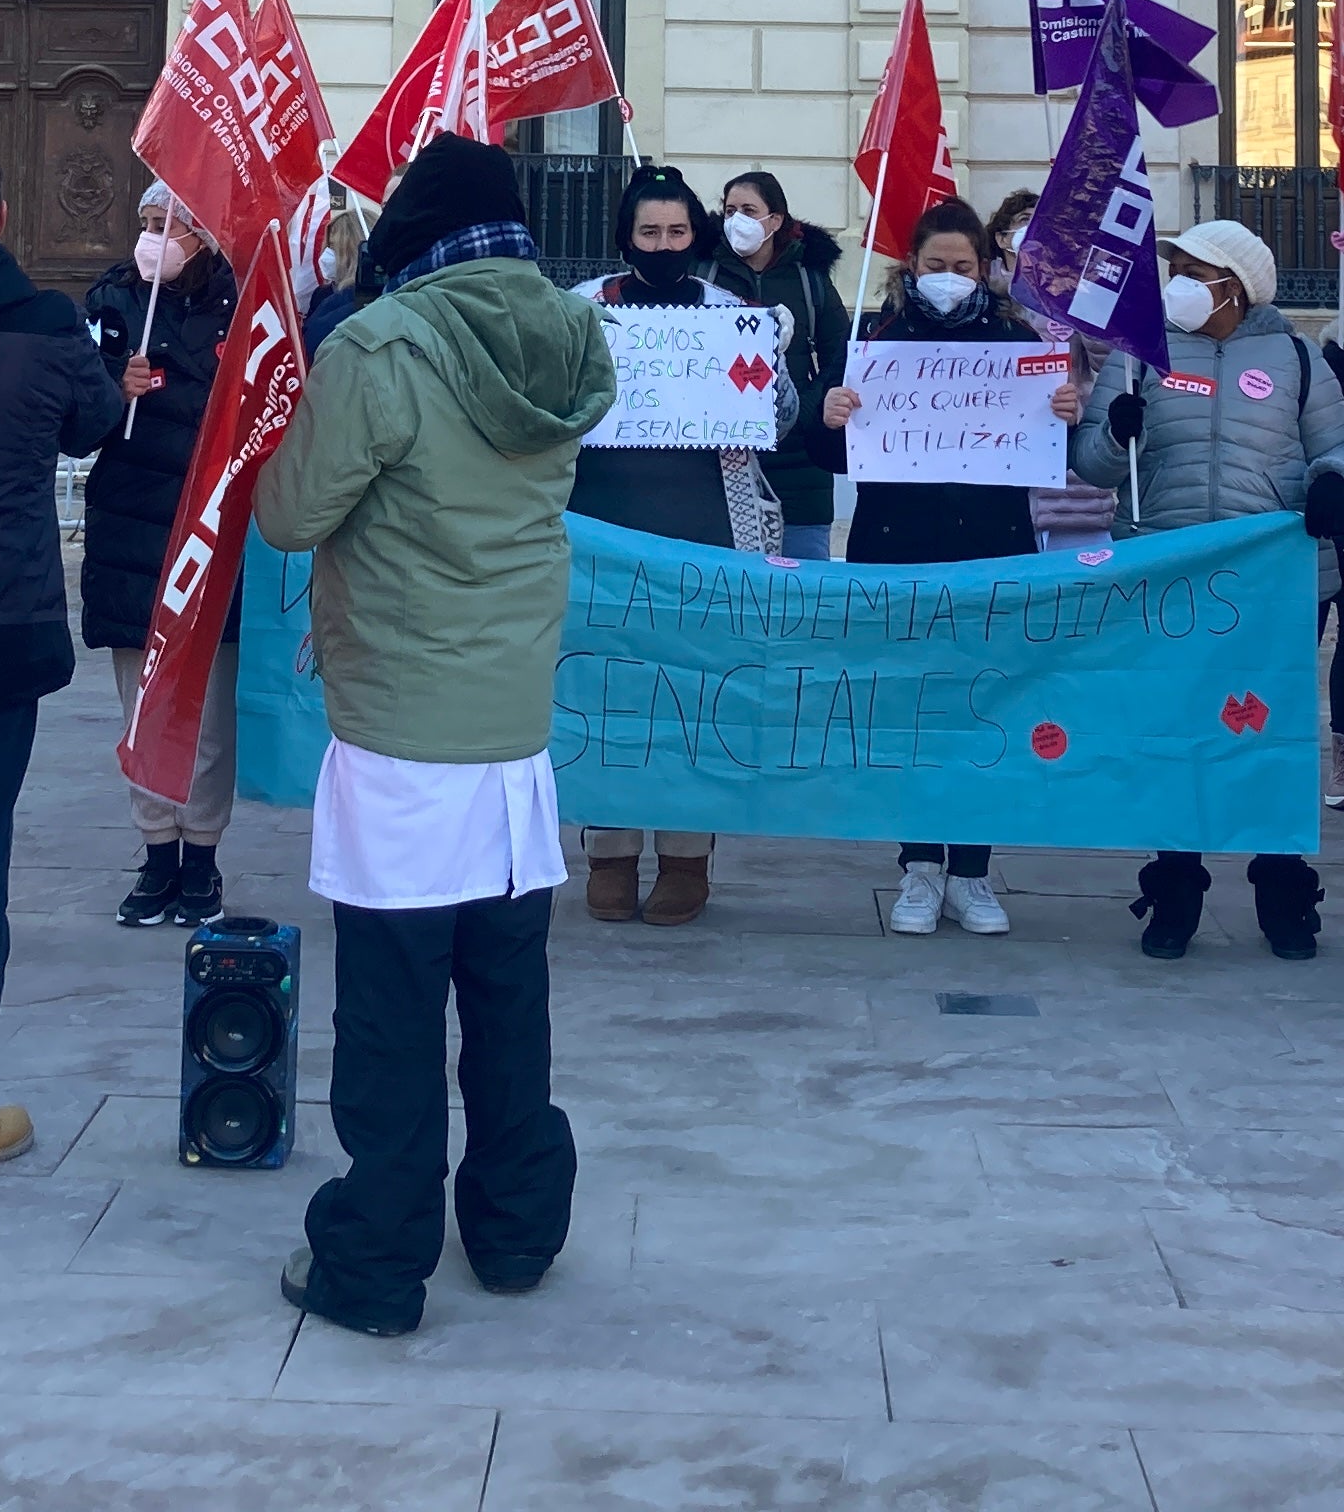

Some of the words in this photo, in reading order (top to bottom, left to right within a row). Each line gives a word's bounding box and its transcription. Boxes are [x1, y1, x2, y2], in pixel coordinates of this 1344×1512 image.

[213, 95, 252, 163] Obreras
[210, 118, 251, 188] Mancha
[626, 323, 706, 353] SOMOS
[614, 356, 726, 383] BASURA
[862, 359, 900, 384] LA
[916, 356, 1015, 381] PATRONA
[1020, 360, 1068, 375] CCOO
[1162, 376, 1212, 396] CCOO
[875, 390, 920, 412] NOS
[930, 390, 1013, 412] QUIERE
[614, 414, 770, 441] ESENCIALES
[882, 429, 1032, 454] UTILIZAR
[587, 555, 657, 632] LA
[677, 563, 956, 642] PANDEMIA
[985, 569, 1241, 644] FUIMOS
[553, 651, 1010, 772] SENCIALES
